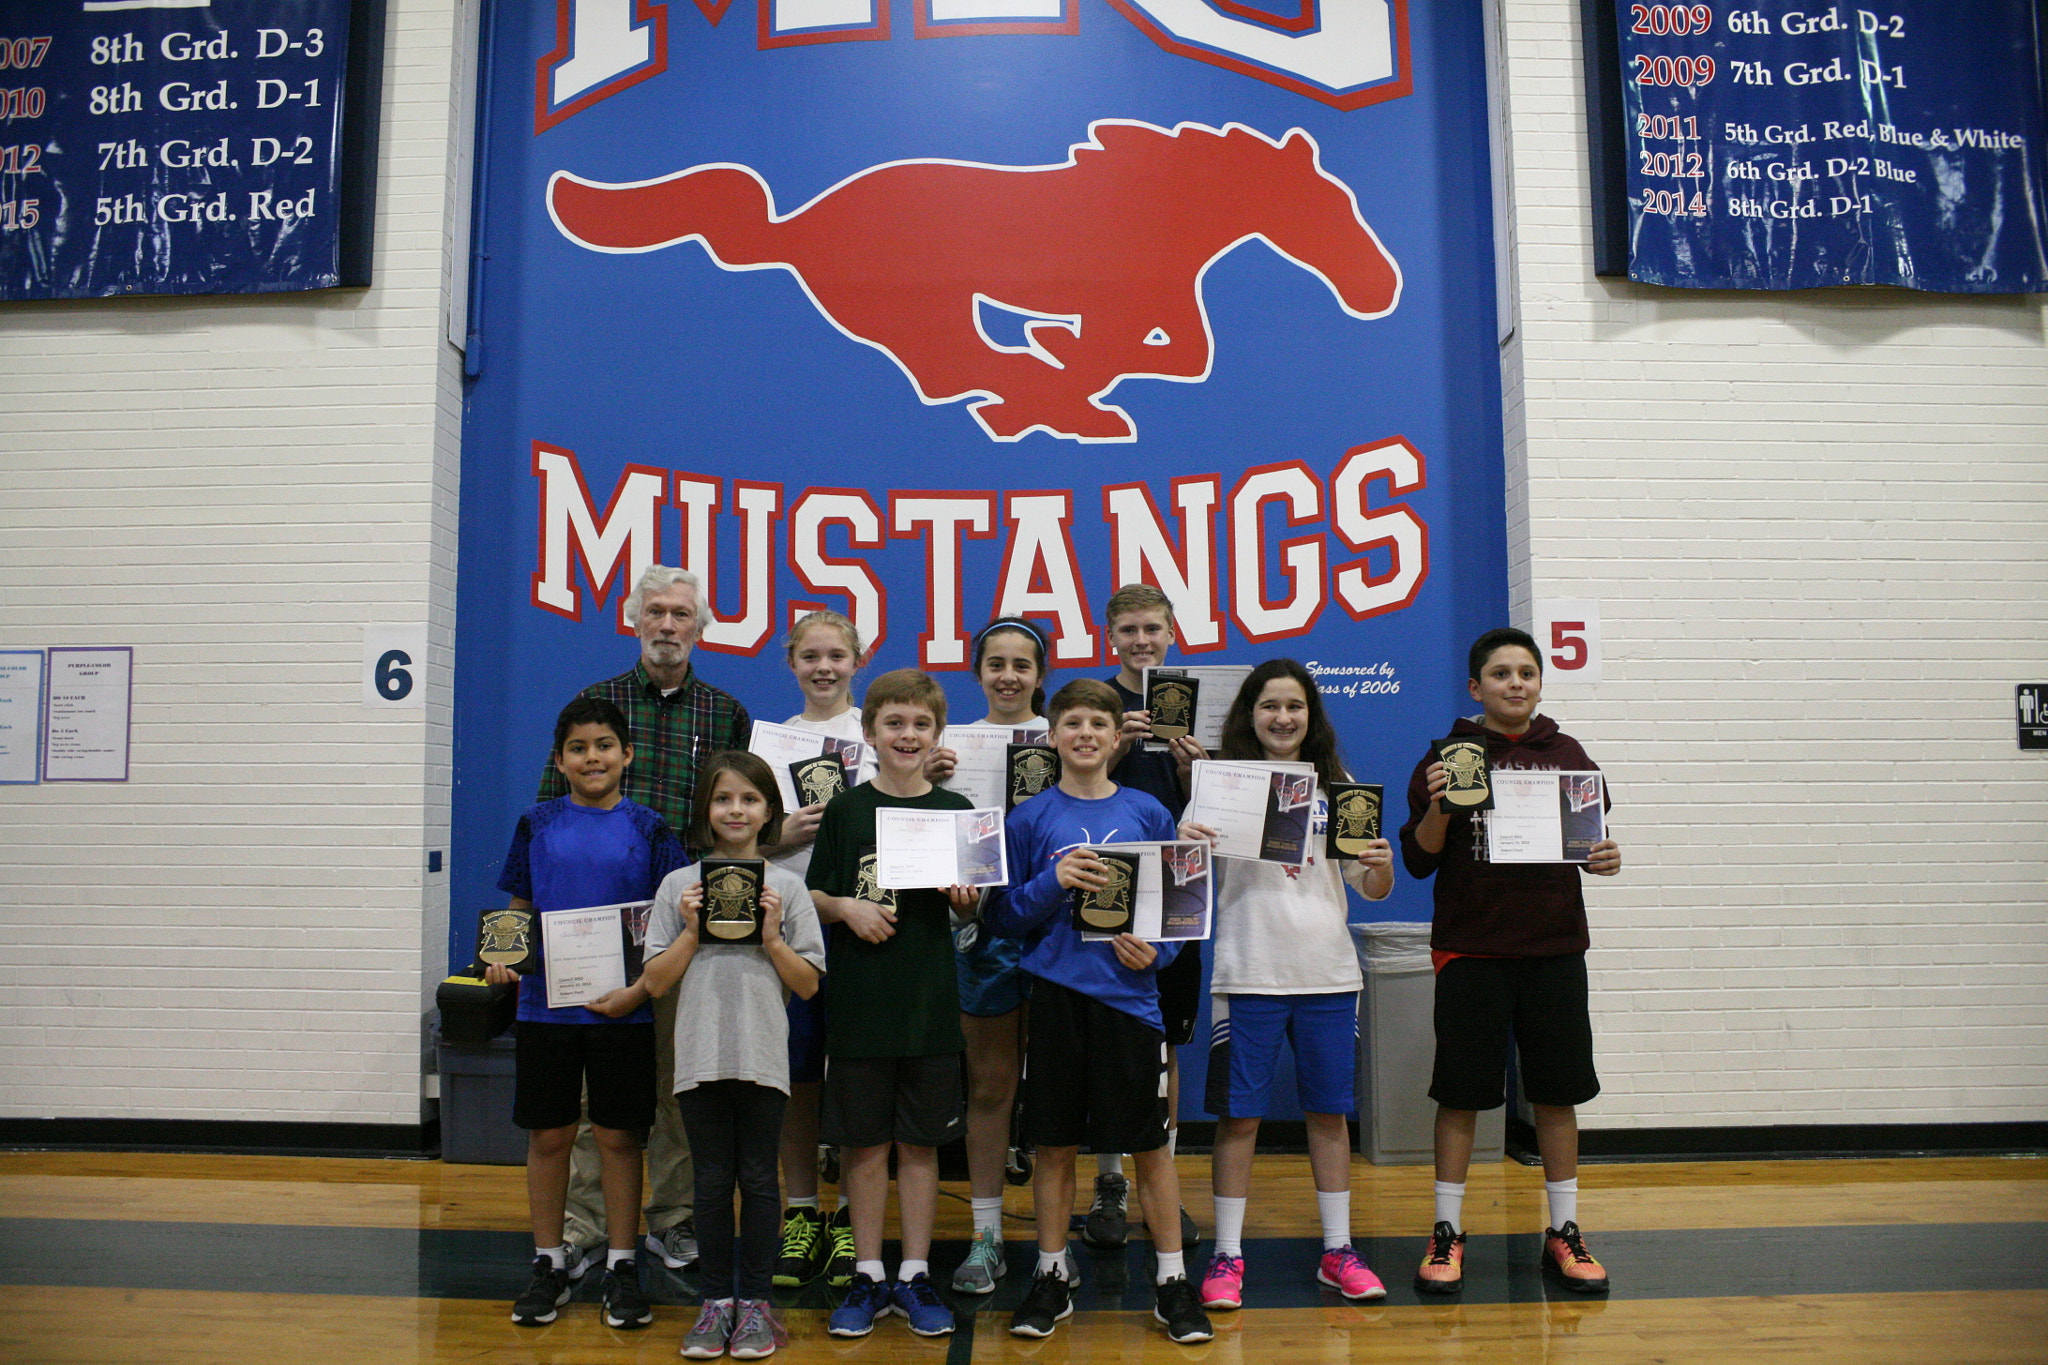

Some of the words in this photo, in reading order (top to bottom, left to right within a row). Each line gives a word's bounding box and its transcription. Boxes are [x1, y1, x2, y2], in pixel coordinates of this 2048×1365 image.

[1630, 3, 1712, 36] 2009
[1727, 10, 1771, 36] 6th
[1780, 8, 1848, 37] Grd.
[1858, 9, 1906, 38] D-2
[0, 36, 53, 70] 007
[90, 33, 145, 65] 8th
[160, 30, 239, 61] Grd.
[256, 28, 325, 59] D-3
[1634, 54, 1716, 88] 2009
[1730, 61, 1773, 87] 7th
[1783, 57, 1851, 87] Grd.
[1862, 59, 1907, 89] D-1
[0, 86, 46, 120] 010
[89, 82, 143, 115] 8th
[159, 80, 238, 112] Grd.
[256, 78, 322, 109] D-1
[1637, 113, 1701, 141] 2011
[1725, 122, 1759, 144] 5th
[1764, 124, 1816, 145] Grd.
[1823, 121, 1876, 142] Red,
[1878, 123, 1923, 148] Blue
[1929, 129, 1949, 149] &
[1953, 128, 2023, 150] White
[0, 144, 41, 174] 12
[97, 138, 148, 171] 7th
[160, 137, 239, 169] Grd.
[251, 136, 314, 167] D-2
[1639, 151, 1705, 178] 2012
[1726, 160, 1761, 181] 6th
[1766, 161, 1820, 182] Grd.
[1827, 158, 1870, 178] D-2
[1874, 160, 1917, 184] Blue
[0, 199, 40, 230] 15
[94, 193, 145, 226] 5th
[157, 191, 236, 223] Grd.
[248, 188, 316, 220] Red
[1642, 188, 1707, 217] 2014
[1728, 201, 1764, 221] 8th
[1769, 199, 1823, 220] Grd.
[1830, 196, 1874, 216] D-1
[530, 434, 1428, 670] MUSTANGS
[1551, 621, 1588, 670] 5
[375, 649, 413, 701] 6
[1306, 661, 1378, 678] Sponsored
[1379, 662, 1395, 679] by
[1316, 681, 1340, 694] ass
[1343, 681, 1358, 698] of
[1360, 681, 1401, 694] 2006
